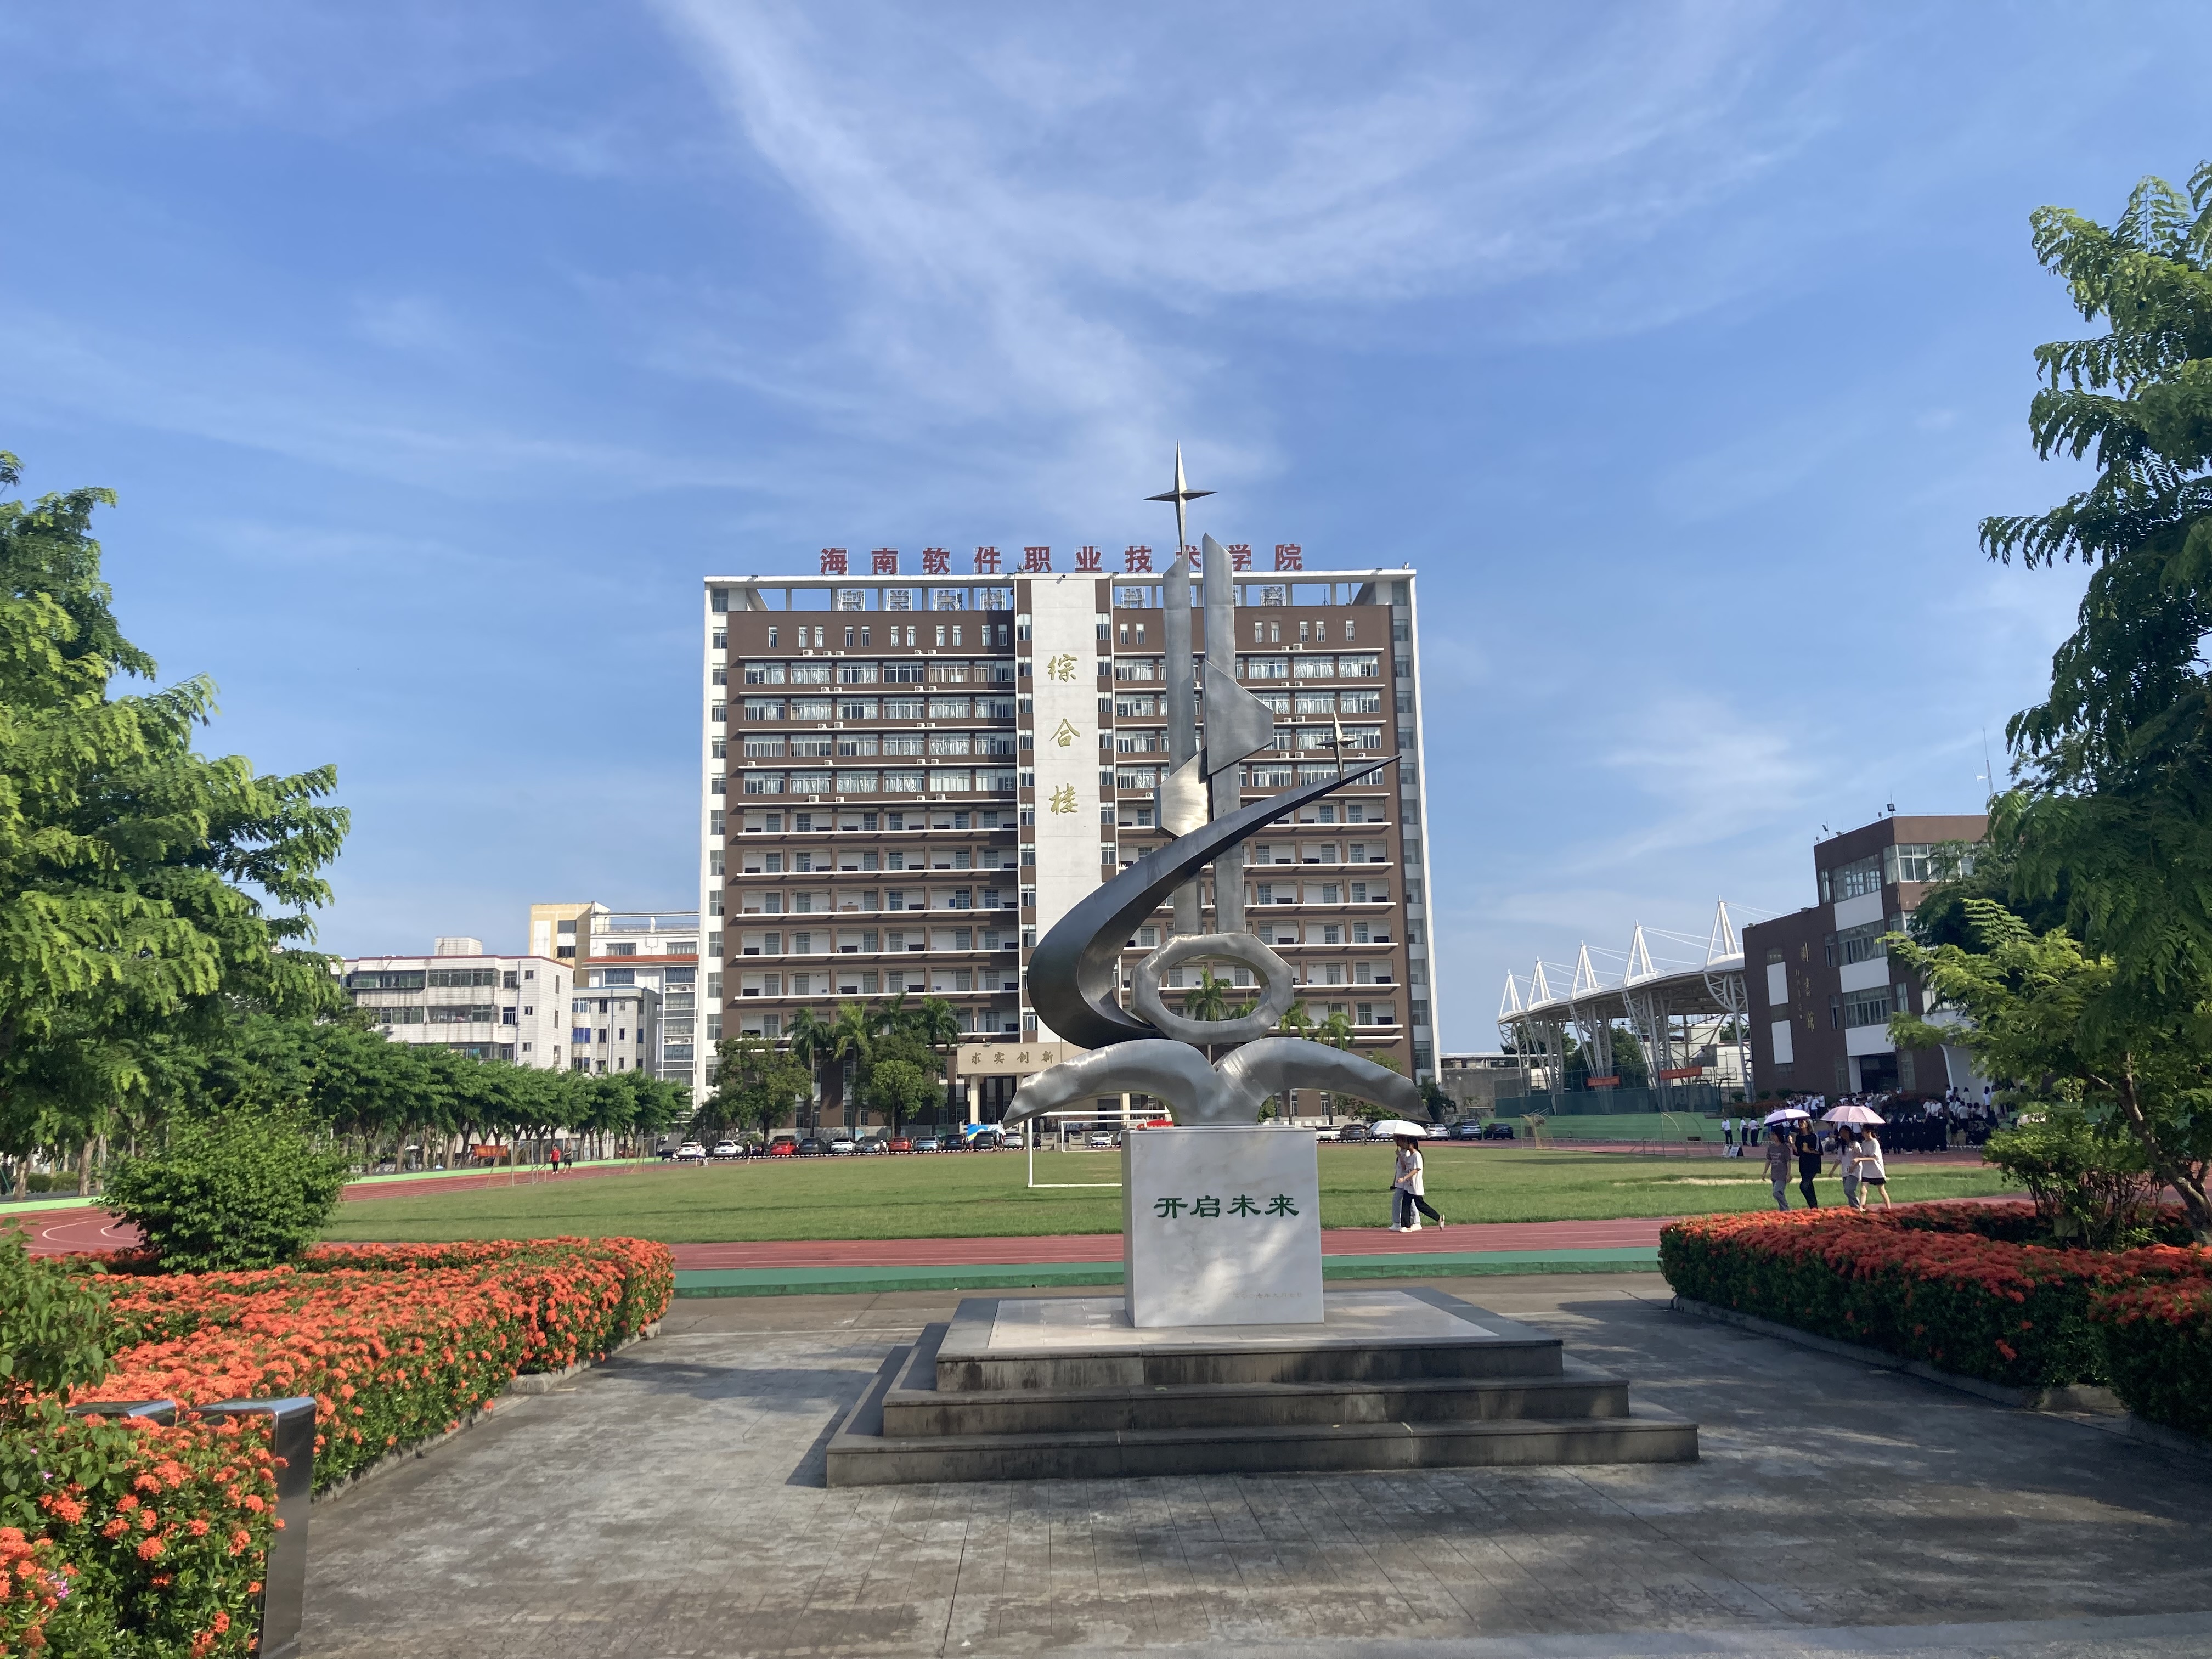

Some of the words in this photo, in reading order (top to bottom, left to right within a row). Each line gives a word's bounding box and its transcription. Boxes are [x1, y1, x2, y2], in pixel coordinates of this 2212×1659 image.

[1048, 653, 1080, 815] 综合楼
[972, 1051, 1053, 1064] 求实创新
[1154, 1194, 1299, 1218] 开启未来
